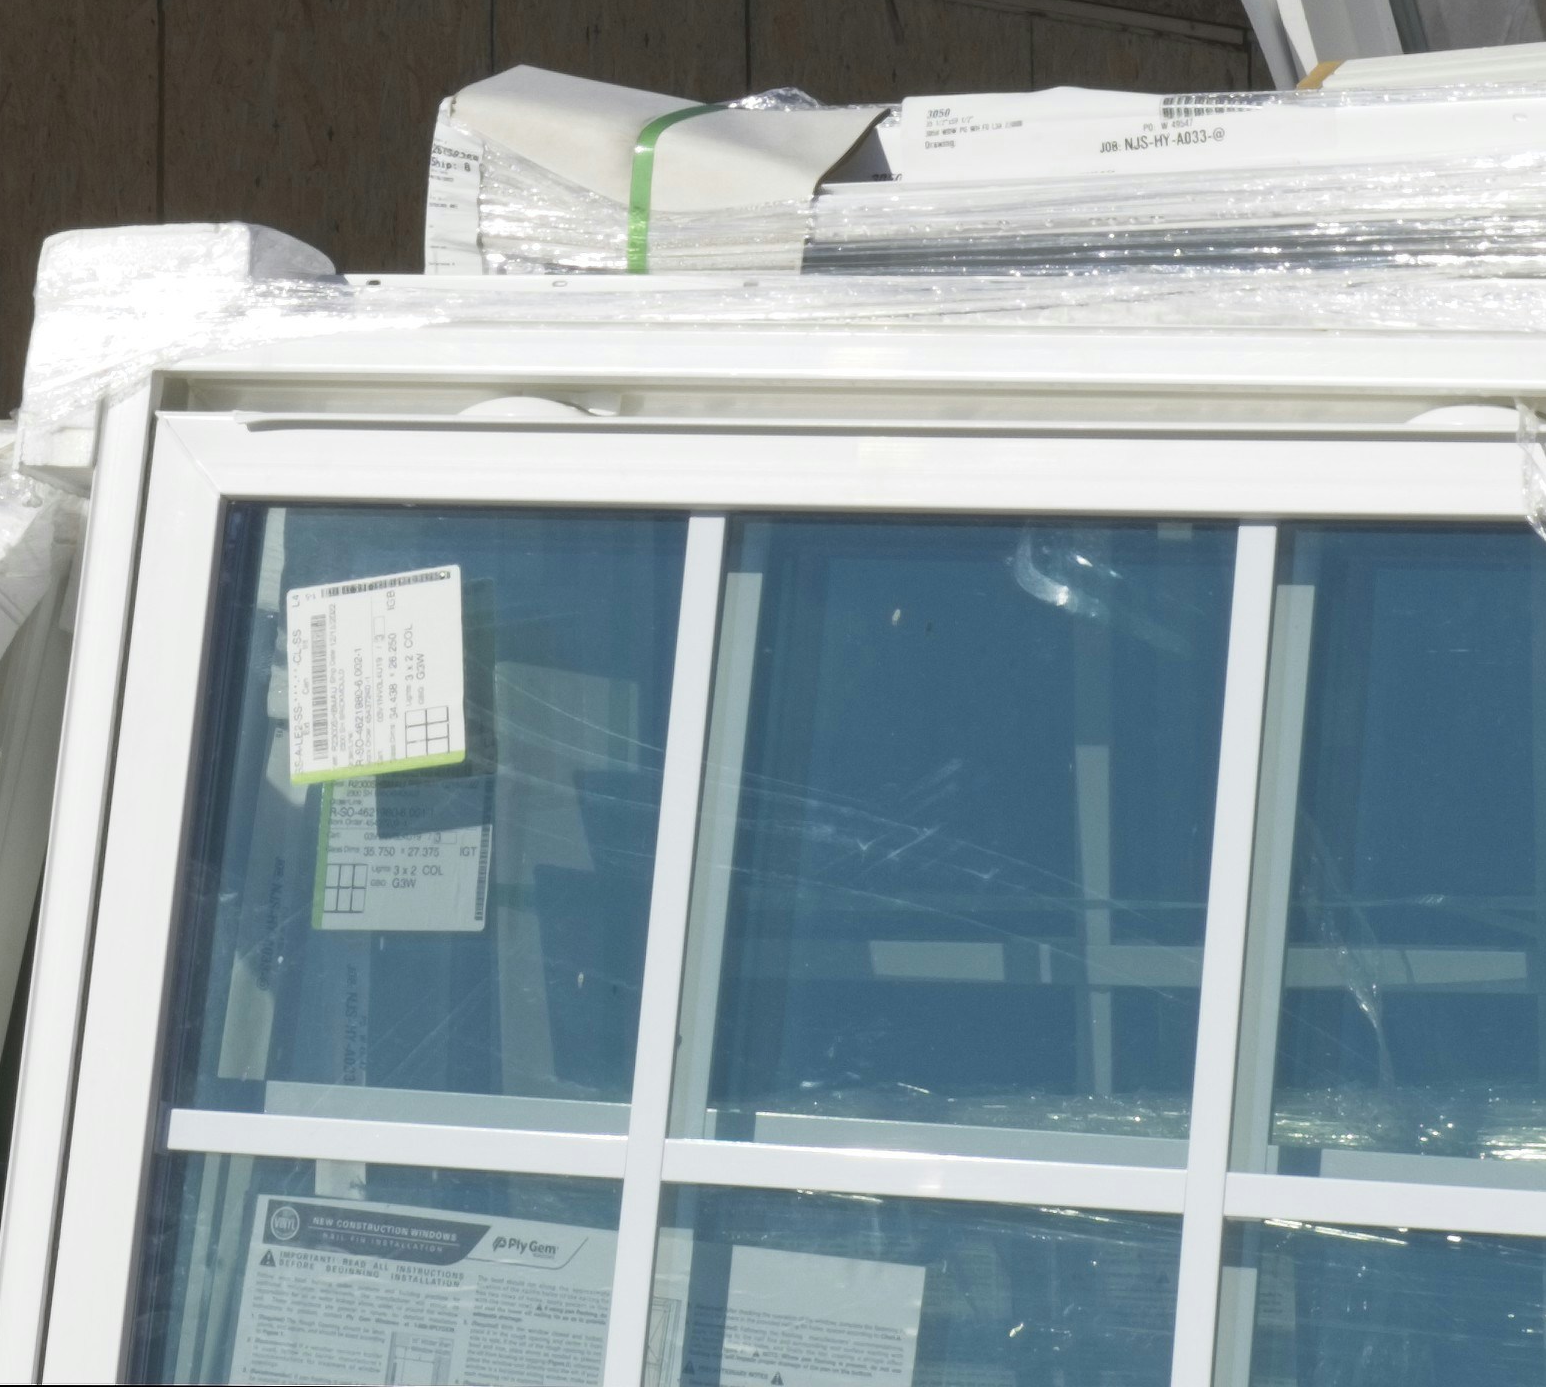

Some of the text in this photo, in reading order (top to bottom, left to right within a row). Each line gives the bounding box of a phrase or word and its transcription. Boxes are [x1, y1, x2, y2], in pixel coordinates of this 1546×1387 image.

[1099, 128, 1226, 155] JOB: NJS-HY-A033-@
[363, 846, 478, 857] 35.750 27.375 IGT
[393, 865, 400, 876] 3
[410, 865, 417, 876] 2
[422, 865, 444, 876] COL
[392, 877, 417, 889] G3W
[312, 1217, 458, 1242] NEW CONSTRUCTION WINDOWS
[508, 1238, 557, 1256] Ply Gem
[279, 1259, 461, 1288] BEFORE BEGINNING INSTALLATION
[343, 1256, 367, 1267] READ
[373, 1261, 390, 1270] ALL
[395, 1264, 465, 1280] INSTRUCTIONS
